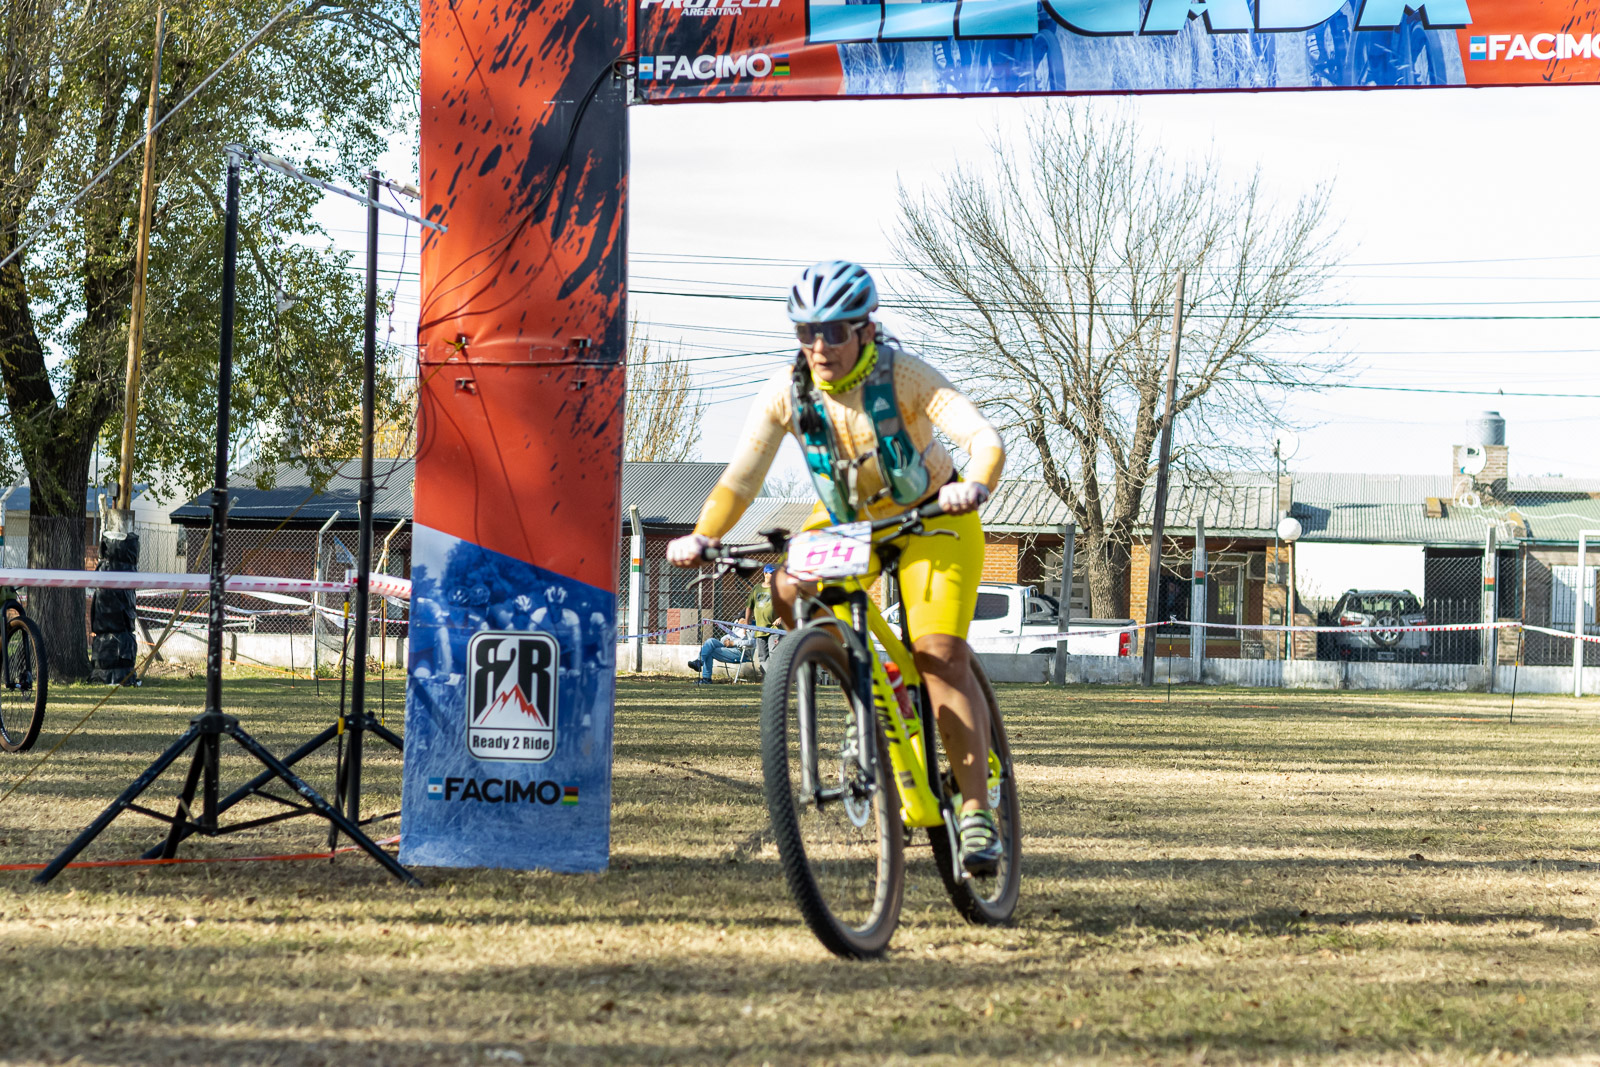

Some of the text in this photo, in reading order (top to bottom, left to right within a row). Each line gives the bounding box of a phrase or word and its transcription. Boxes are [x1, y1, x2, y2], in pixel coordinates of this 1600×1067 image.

[680, 7, 742, 16] ARGENTINA
[655, 53, 772, 80] FACIMO
[805, 541, 855, 567] 64
[472, 735, 550, 750] Ready 2 Ride
[444, 777, 561, 806] FACIMO
